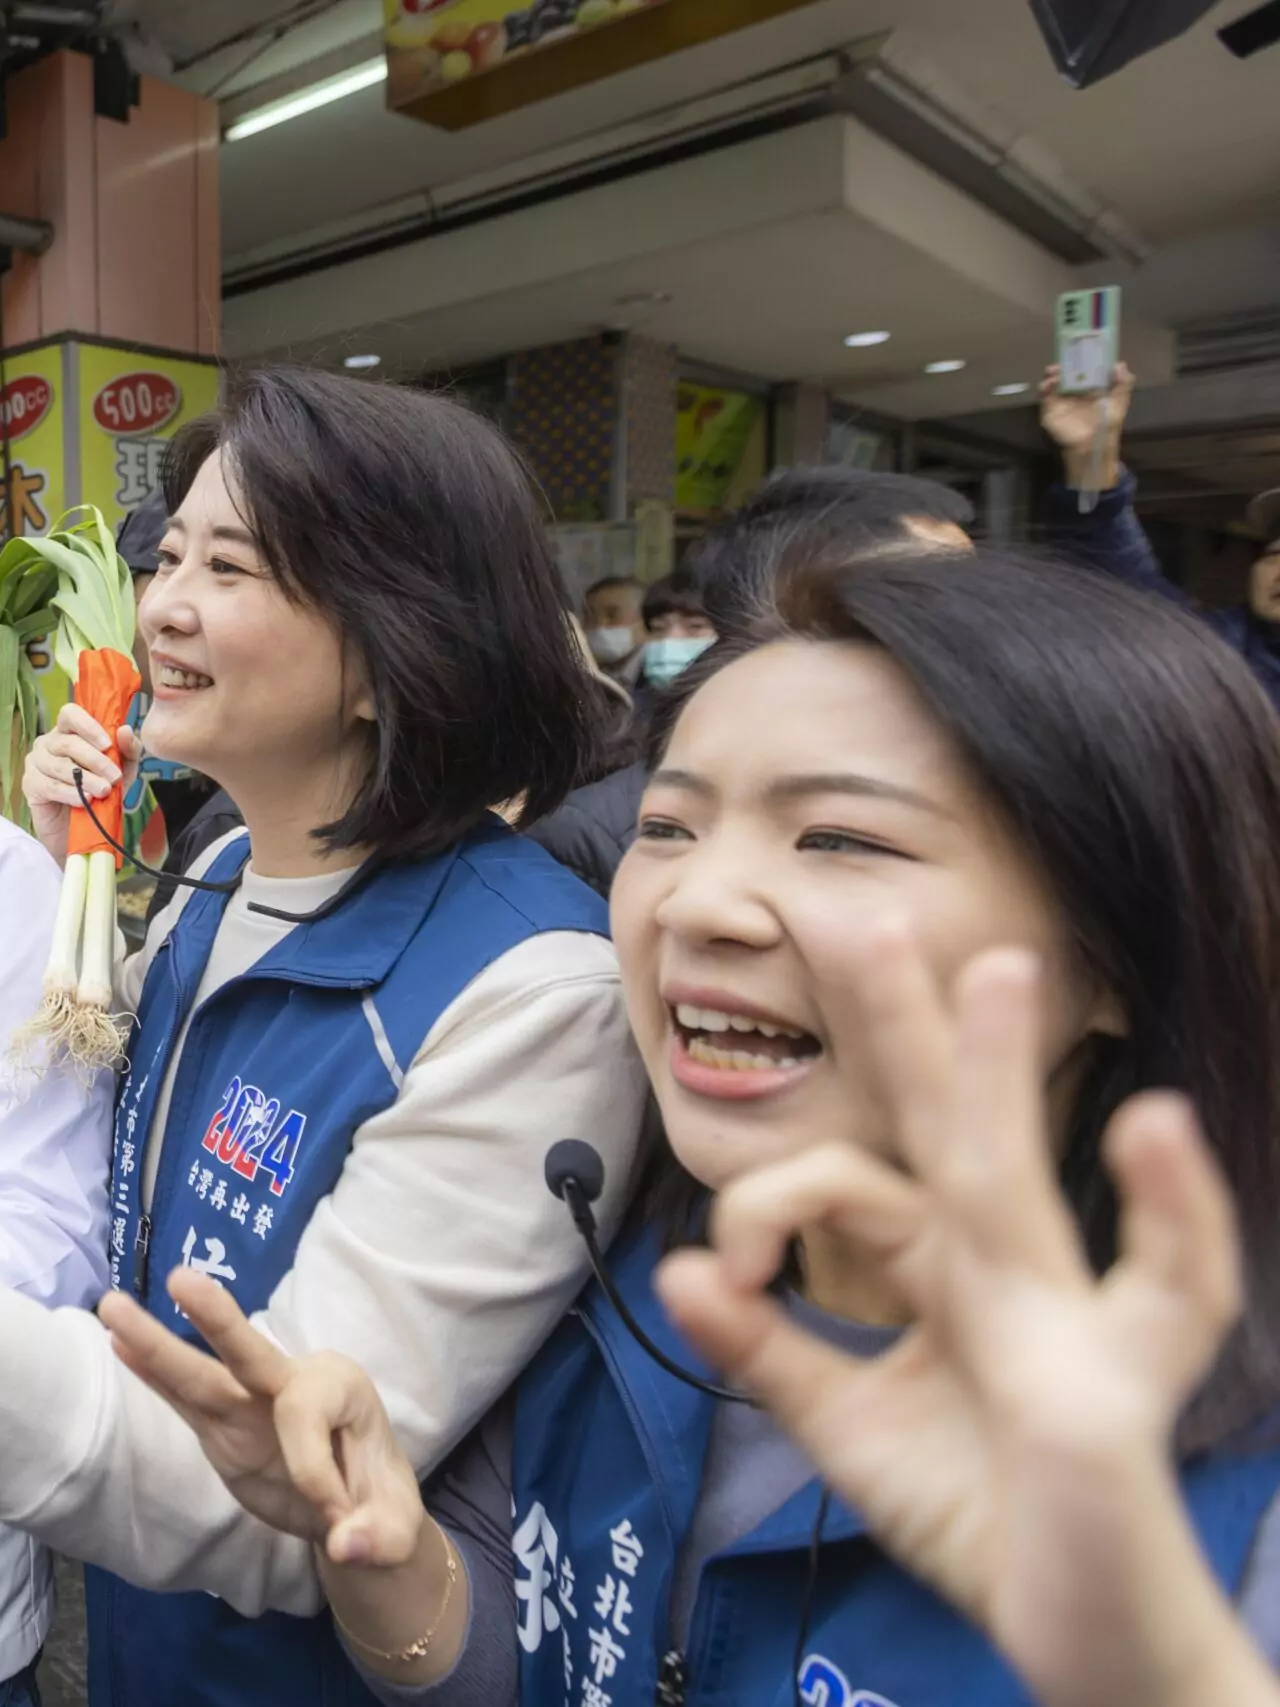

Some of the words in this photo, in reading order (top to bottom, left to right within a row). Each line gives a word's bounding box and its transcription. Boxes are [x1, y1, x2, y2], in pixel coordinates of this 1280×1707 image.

[201, 1075, 307, 1198] 2024
[187, 1158, 275, 1241] 台灣再出發
